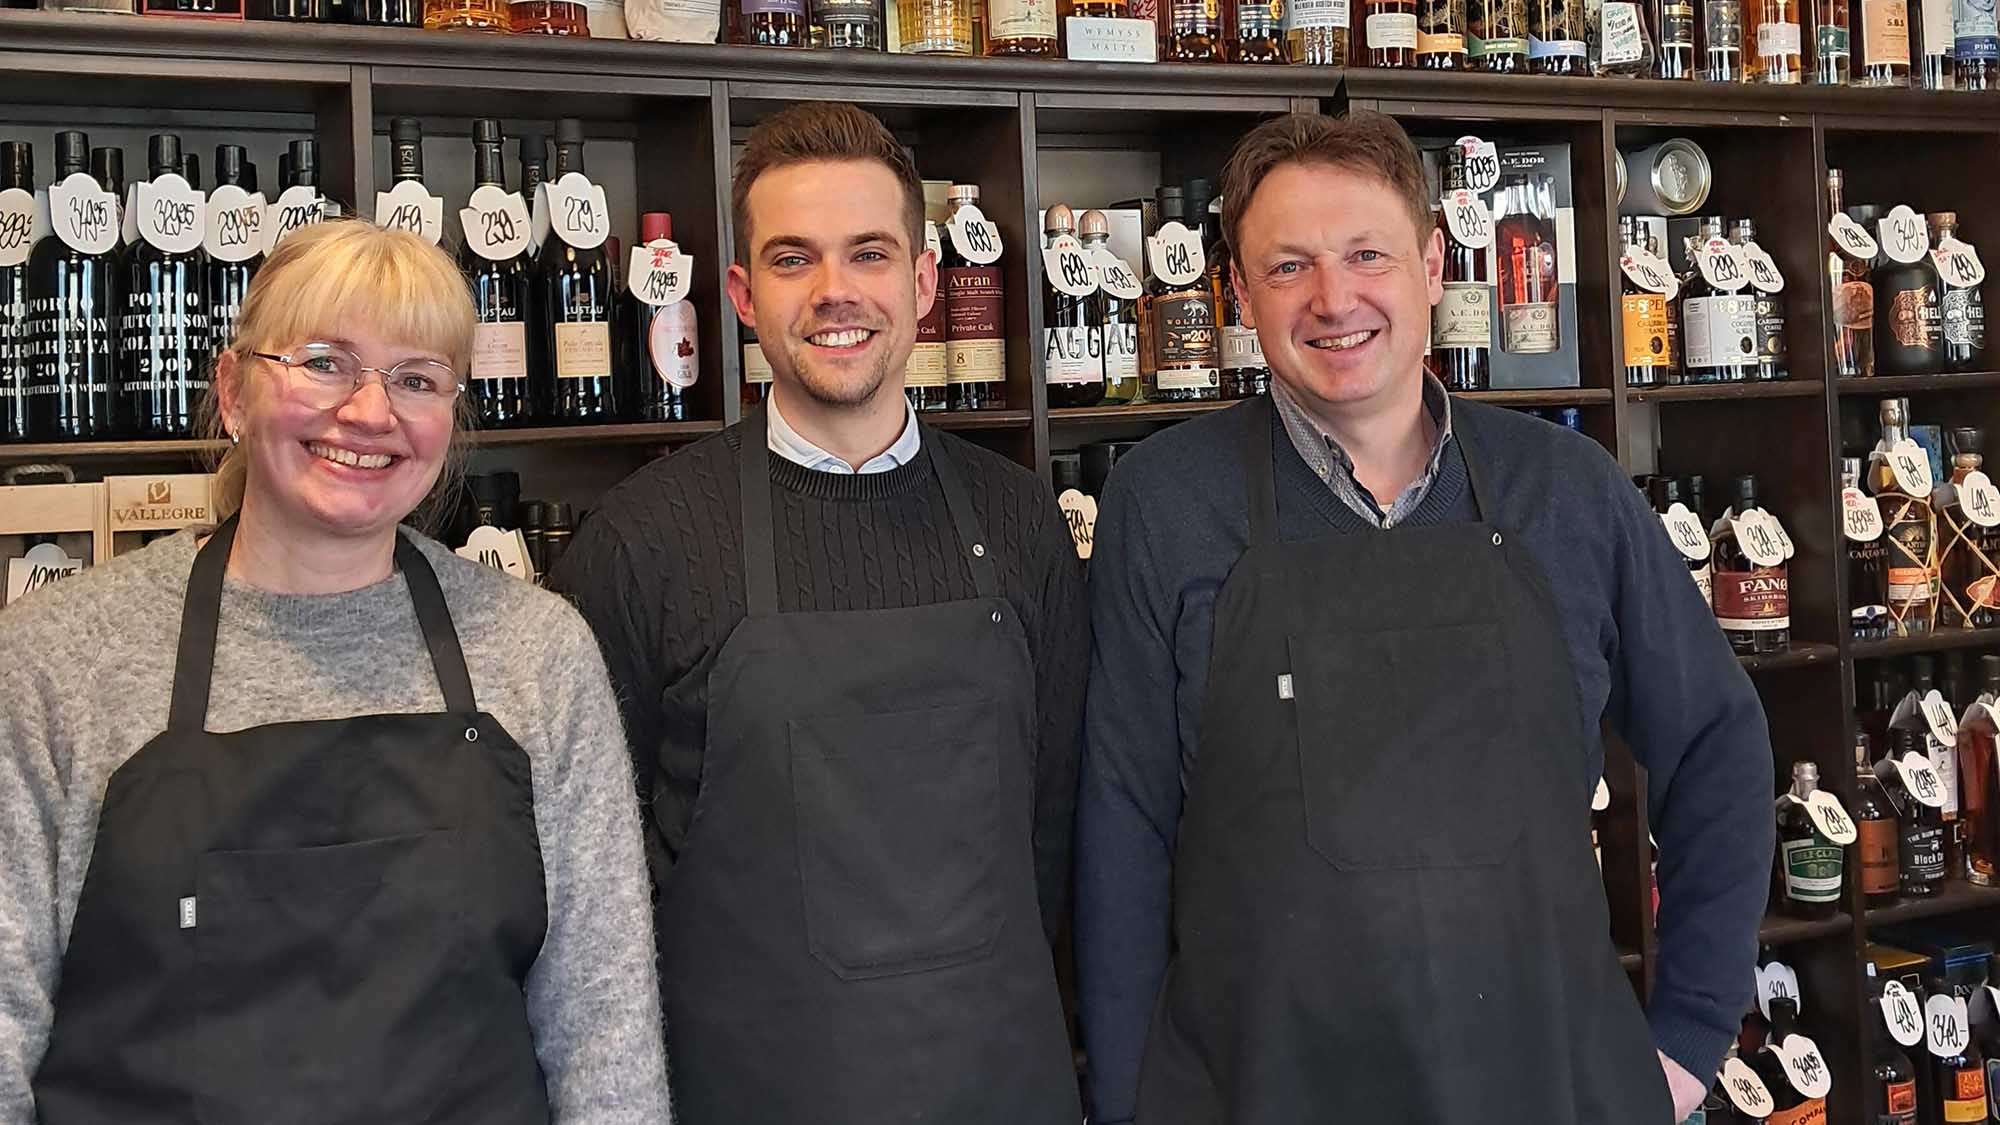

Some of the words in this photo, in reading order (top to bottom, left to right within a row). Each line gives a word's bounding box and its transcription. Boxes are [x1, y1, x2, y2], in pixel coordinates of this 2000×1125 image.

[1085, 26, 1142, 38] WEMYSS
[1091, 42, 1137, 52] MALTS
[949, 275, 991, 287] Arran
[951, 323, 977, 333] Private
[956, 352, 966, 364] 8
[114, 506, 206, 523] VALLEGRE
